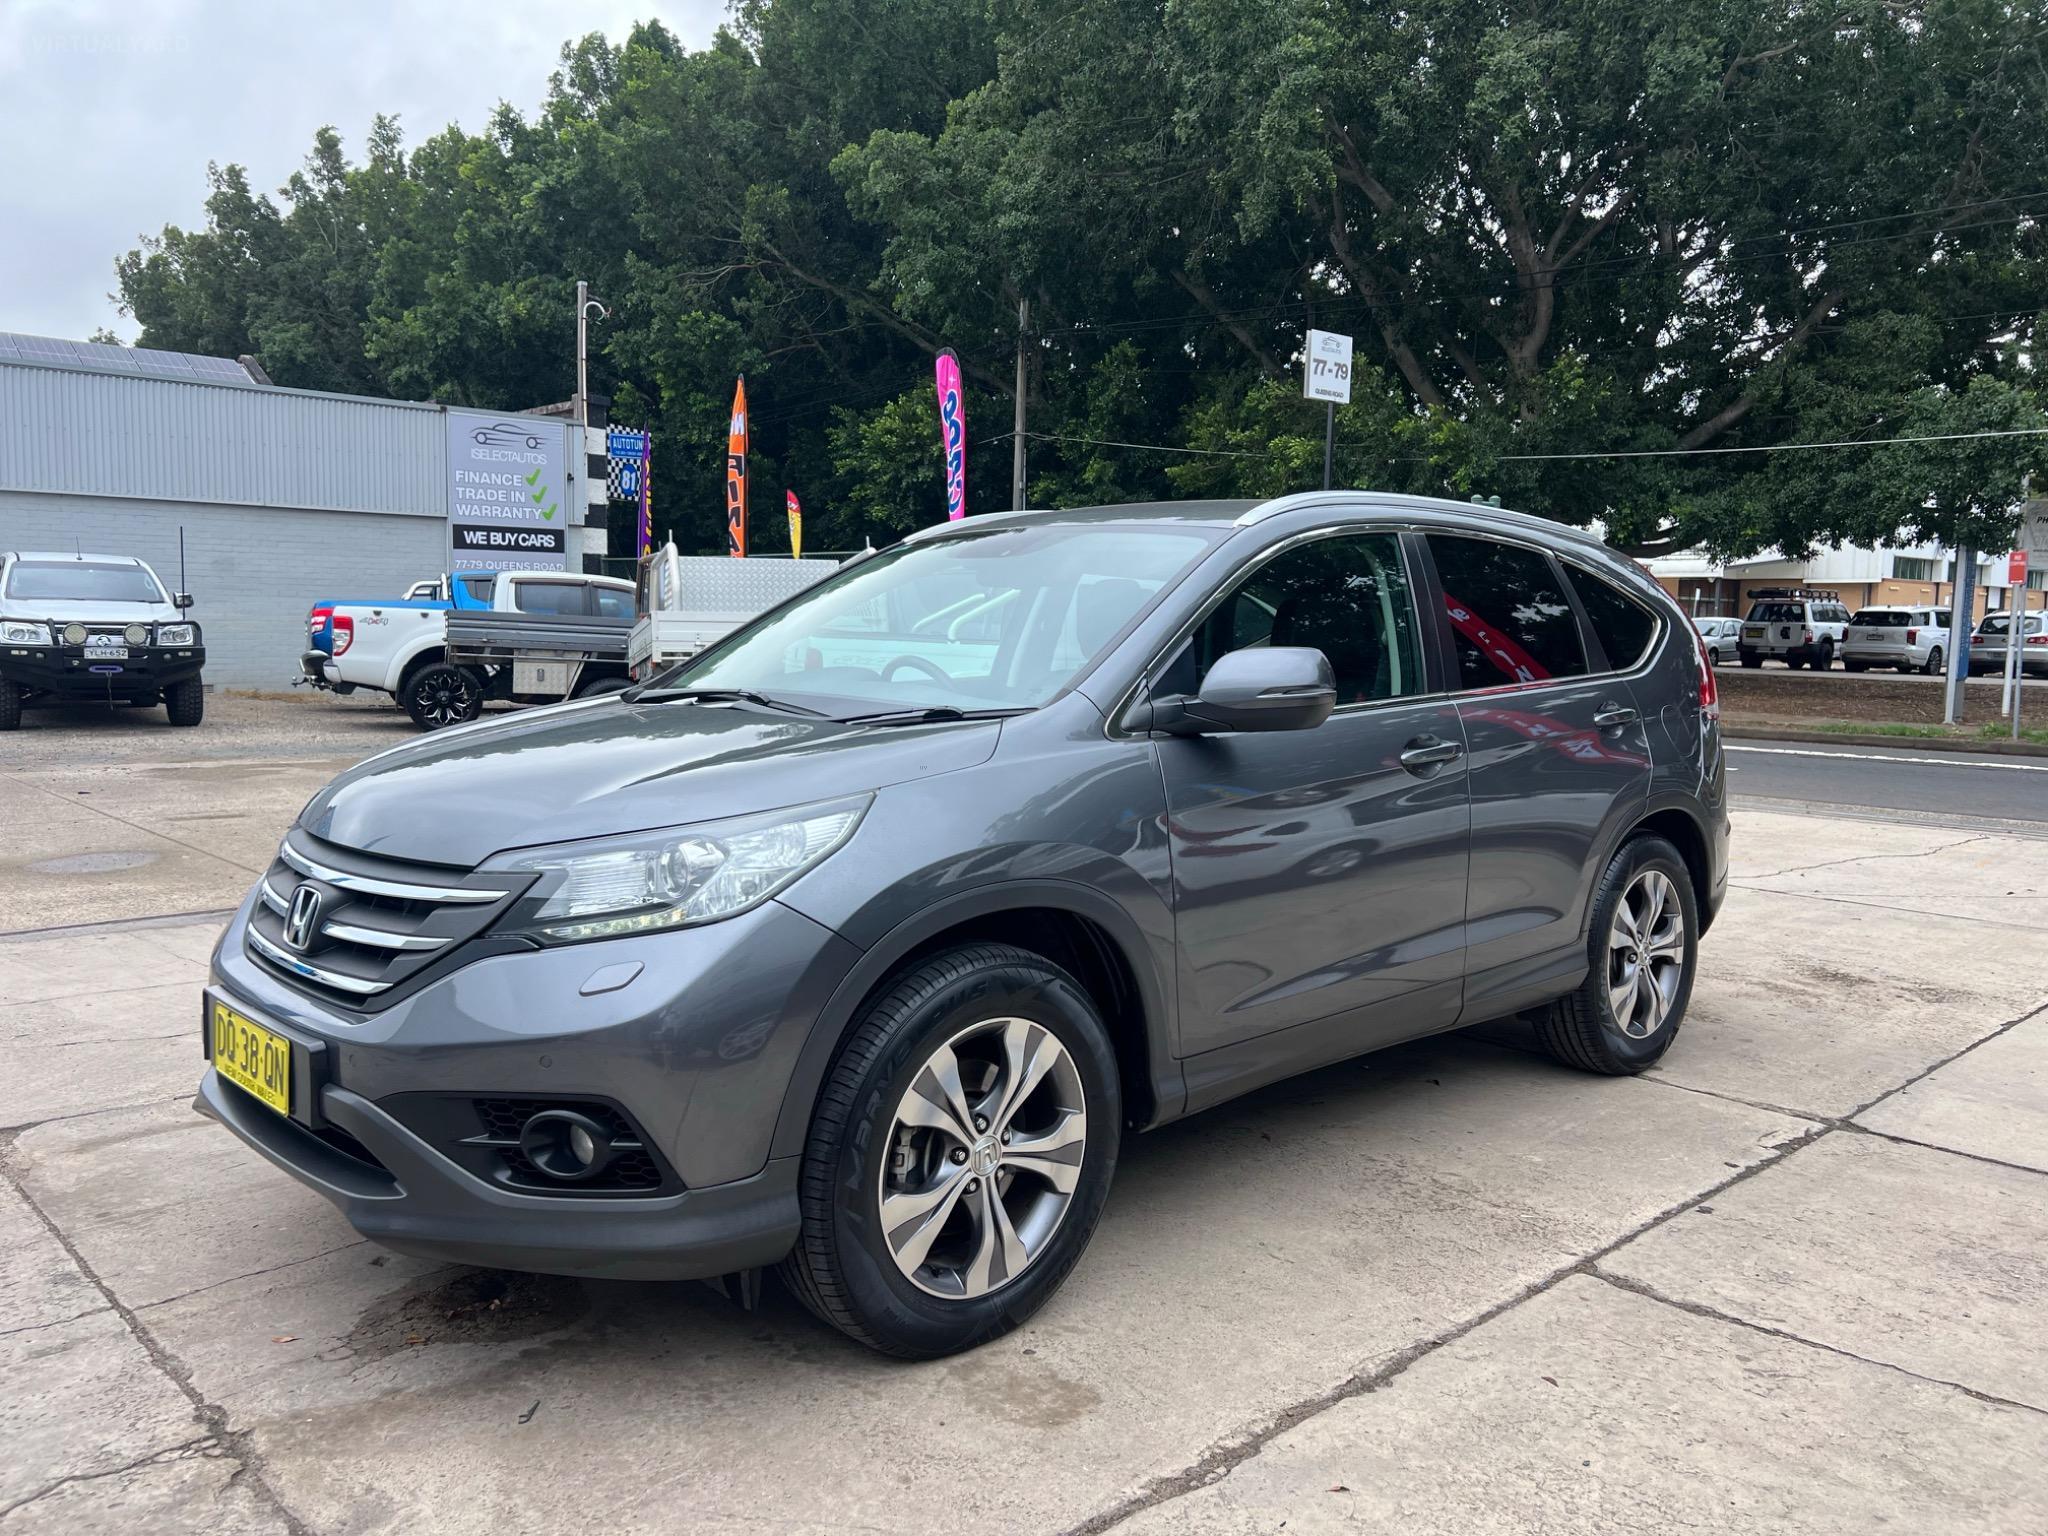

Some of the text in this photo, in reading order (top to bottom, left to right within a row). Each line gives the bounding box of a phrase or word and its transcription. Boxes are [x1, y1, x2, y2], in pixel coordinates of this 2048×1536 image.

[613, 437, 643, 451] AUTOTUN
[455, 470, 522, 486] FINANCE
[621, 470, 636, 490] 81
[455, 487, 525, 503] TRADE IN
[456, 503, 542, 520] WARRANTY
[463, 530, 555, 548] WE BUY CARS
[455, 560, 564, 572] 77-79 QUEENS ROAD
